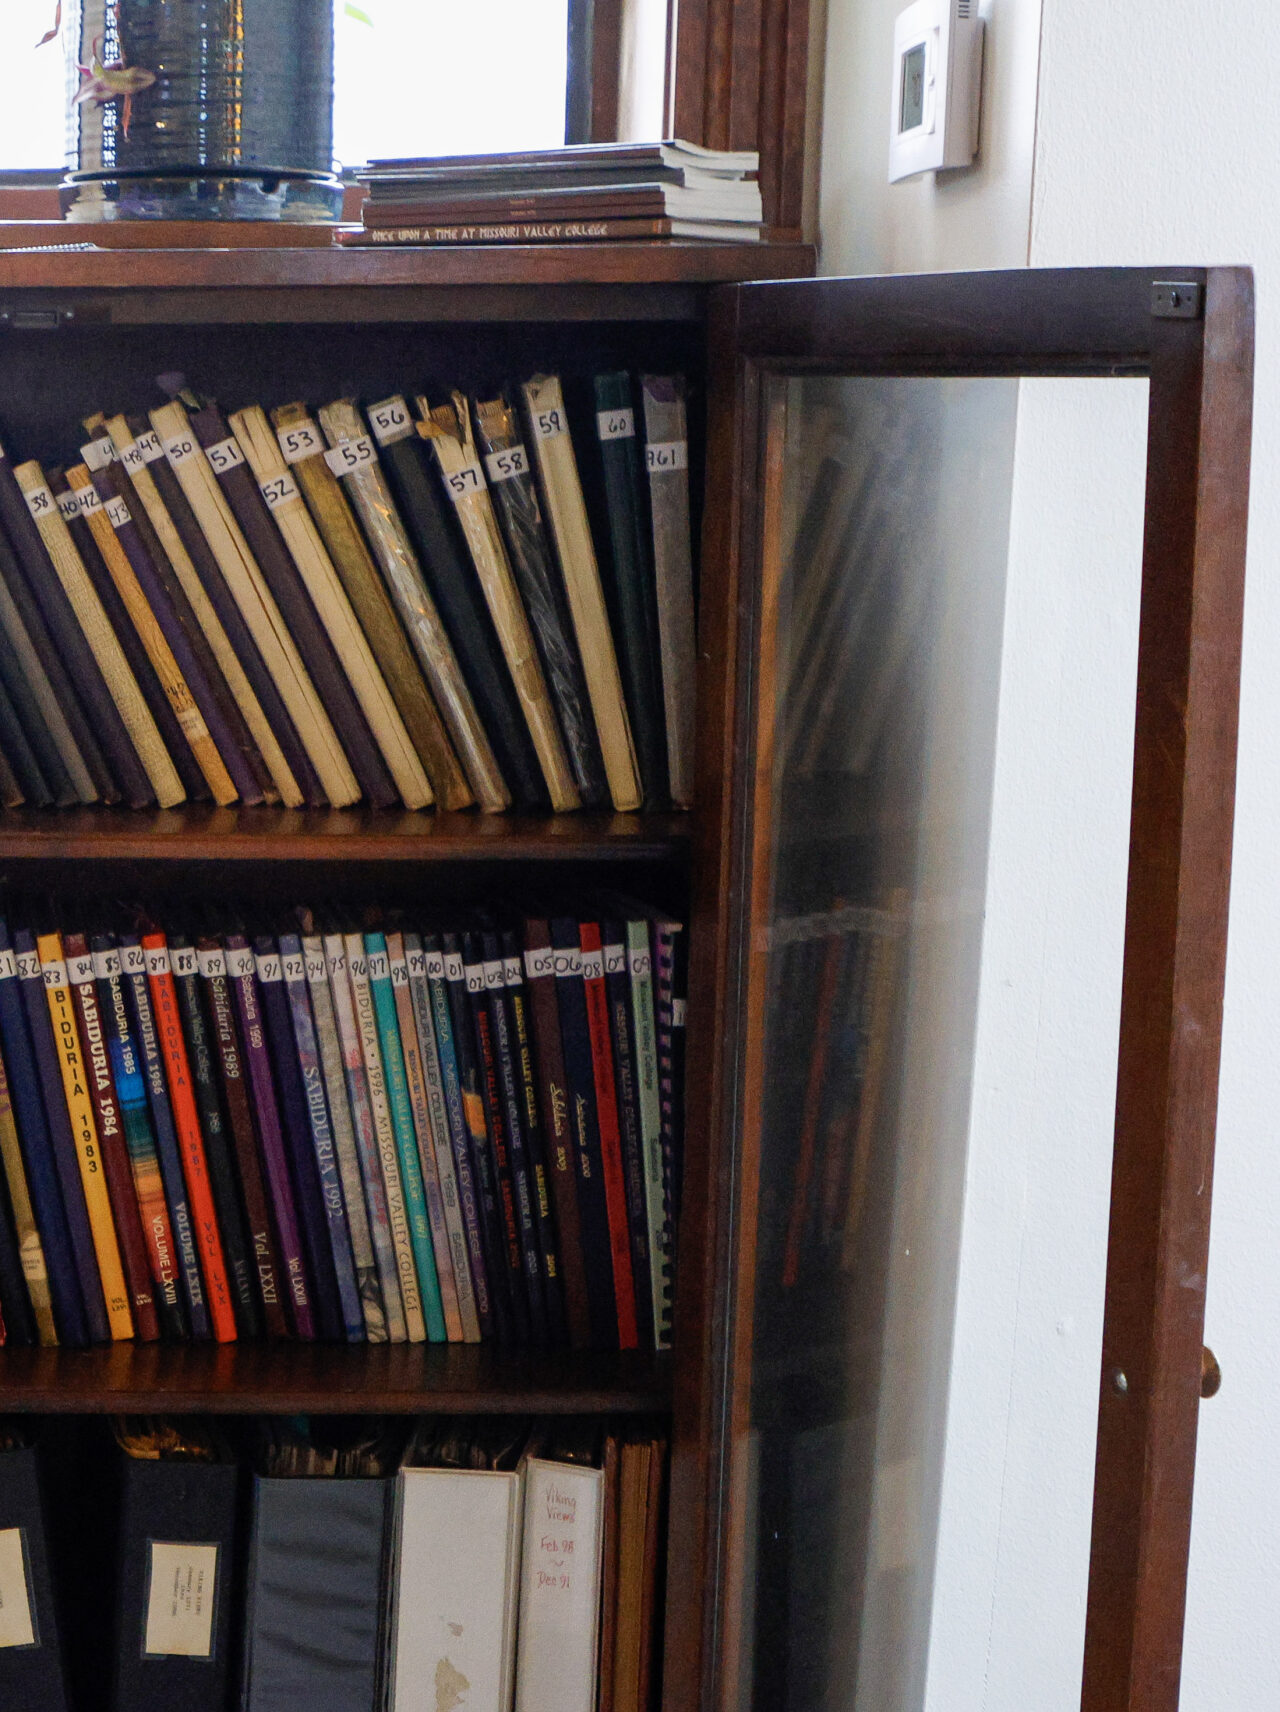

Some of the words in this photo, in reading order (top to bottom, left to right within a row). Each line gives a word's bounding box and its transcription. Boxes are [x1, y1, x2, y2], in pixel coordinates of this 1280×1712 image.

[372, 231, 394, 241] ONCE
[399, 229, 420, 240] UPON
[424, 231, 430, 240] A
[436, 229, 457, 240] TIME
[462, 229, 475, 239] AT
[479, 227, 519, 238] MISSOURI
[524, 226, 561, 237] VALLEY
[566, 224, 607, 235] COLLEGE
[376, 410, 404, 428] 56
[540, 412, 560, 433] 59
[609, 418, 626, 432] 60
[141, 435, 159, 451] 49
[170, 442, 192, 458] 50
[287, 431, 314, 452] 53
[124, 450, 142, 464] 48
[211, 446, 237, 466] 51
[342, 441, 370, 465] 55
[497, 453, 522, 474] 58
[450, 470, 478, 492] 57
[79, 491, 101, 509] 42
[263, 480, 294, 503] 52
[32, 492, 48, 512] 38
[59, 501, 78, 514] 40
[109, 503, 128, 520] 43
[18, 959, 40, 976] 82
[77, 961, 94, 975] 84
[105, 958, 119, 971] 85
[151, 958, 165, 970] 87
[178, 955, 192, 969] 88
[208, 960, 221, 973] 89
[238, 959, 252, 972] 90
[264, 964, 278, 978] 91
[286, 961, 303, 975] 92
[308, 961, 323, 977] 94
[330, 957, 344, 969] 95
[352, 962, 366, 976] 96
[370, 959, 384, 973] 97
[410, 955, 424, 971] 99
[428, 962, 441, 973] 00
[450, 963, 461, 975] 01
[534, 957, 551, 971] 05
[554, 956, 582, 972] 06
[584, 963, 600, 977] 08
[633, 956, 650, 973] 09
[44, 970, 60, 983] 83
[393, 967, 407, 981] 98
[469, 977, 484, 989] 02
[487, 973, 503, 984] 03
[239, 975, 259, 1021] Sabiduria
[109, 975, 129, 1044] SABIDURIA
[210, 977, 234, 1041] Sabiduria
[247, 1024, 263, 1048] 1990
[79, 983, 112, 1091] SABIDURIA
[100, 1098, 118, 1136] 1984
[122, 1046, 136, 1075] 1985
[221, 1046, 240, 1078] 1989
[421, 1042, 440, 1087] VALLEY
[368, 1065, 385, 1096] 1996
[442, 1064, 464, 1131] MISSOURI
[429, 1092, 449, 1146] COLLEGE
[82, 1114, 98, 1173] 1983
[132, 975, 159, 1060] SABIDURIA
[147, 1064, 165, 1095] 1986
[173, 1202, 195, 1263] VOLUME
[185, 1265, 203, 1306] LXIX
[303, 1066, 336, 1174] SABIDURIA
[322, 1182, 344, 1218] 1992
[376, 1116, 400, 1189] MISSOURI
[452, 1135, 474, 1189] VALLEY
[388, 1192, 409, 1246] VALLEY
[461, 1191, 484, 1259] COLLEGE
[150, 1216, 171, 1267] VOLUME
[252, 1232, 270, 1259] Vol.
[287, 1257, 302, 1276] Vol.
[160, 1269, 179, 1306] LXVIII
[258, 1265, 278, 1304] LXXII
[397, 1252, 420, 1312] COLLEGE
[291, 1277, 308, 1306] LXXIII
[474, 1278, 491, 1314] 2000
[545, 1483, 576, 1507] Viking
[546, 1508, 575, 1523] Views
[541, 1535, 559, 1552] Feb
[537, 1571, 557, 1588] Dec
